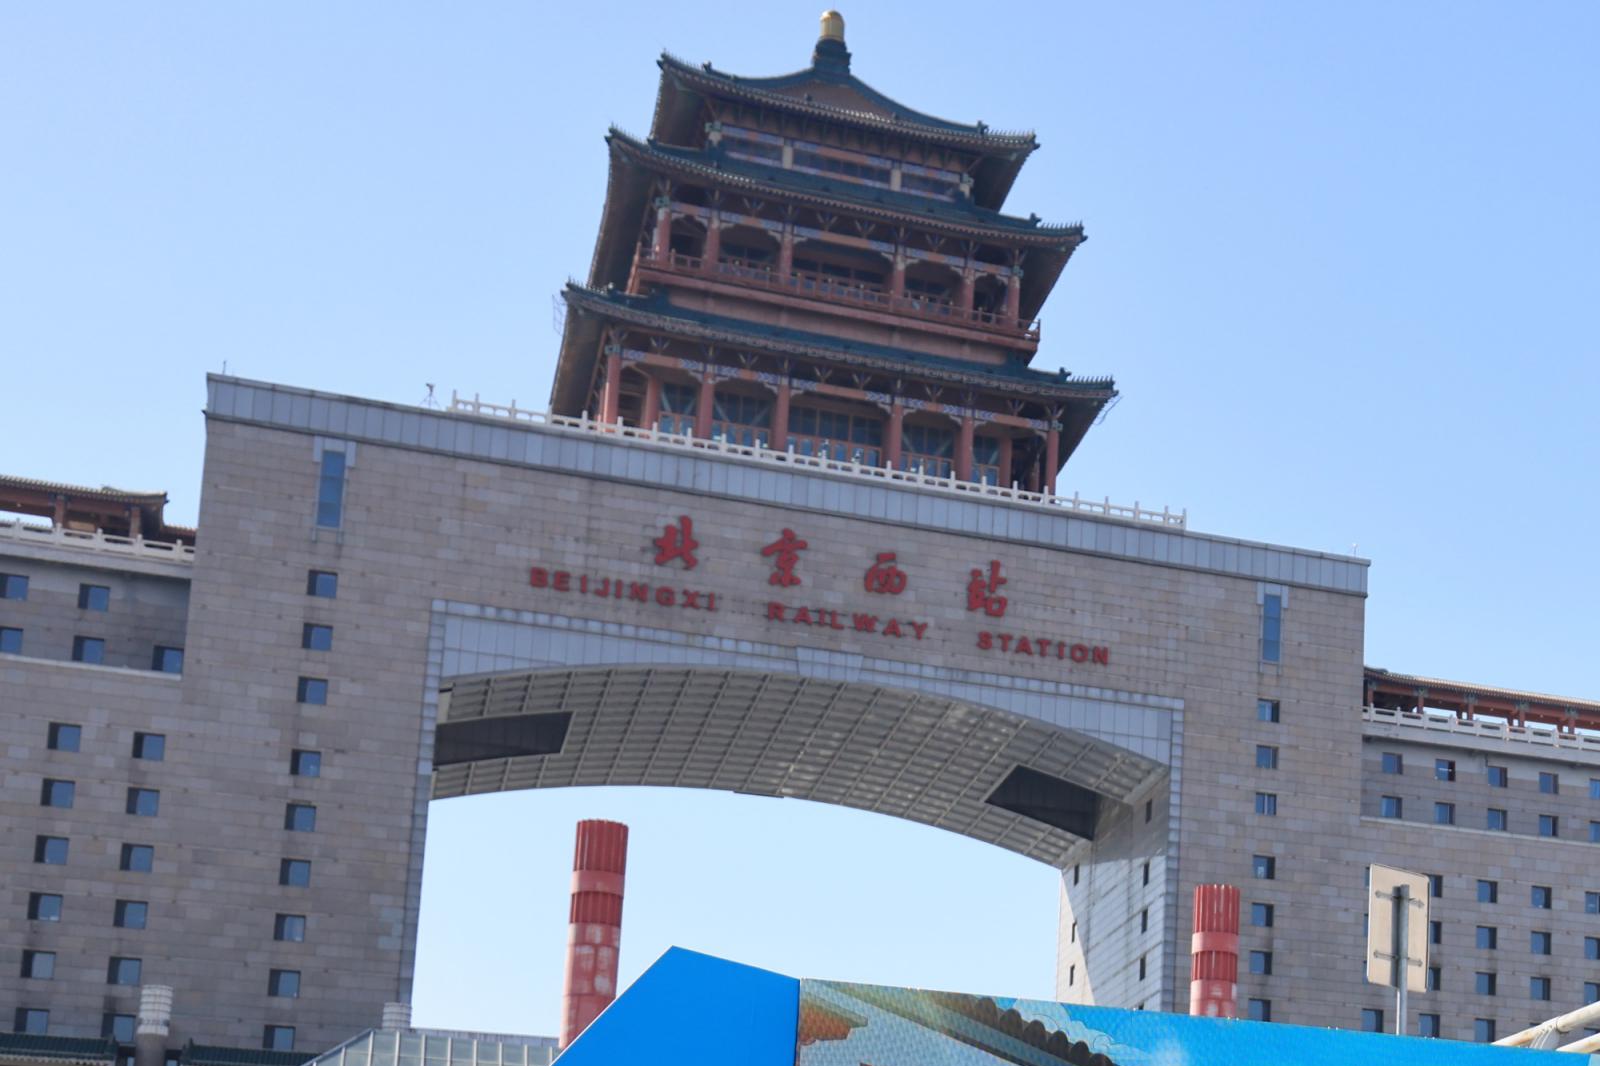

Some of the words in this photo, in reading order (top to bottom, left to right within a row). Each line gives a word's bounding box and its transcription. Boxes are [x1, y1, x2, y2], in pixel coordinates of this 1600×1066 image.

[528, 565, 719, 612] BEIJINGXI
[766, 600, 928, 640] RAILWAY
[975, 631, 1110, 666] STATION
[652, 515, 1009, 618] 北京西站
